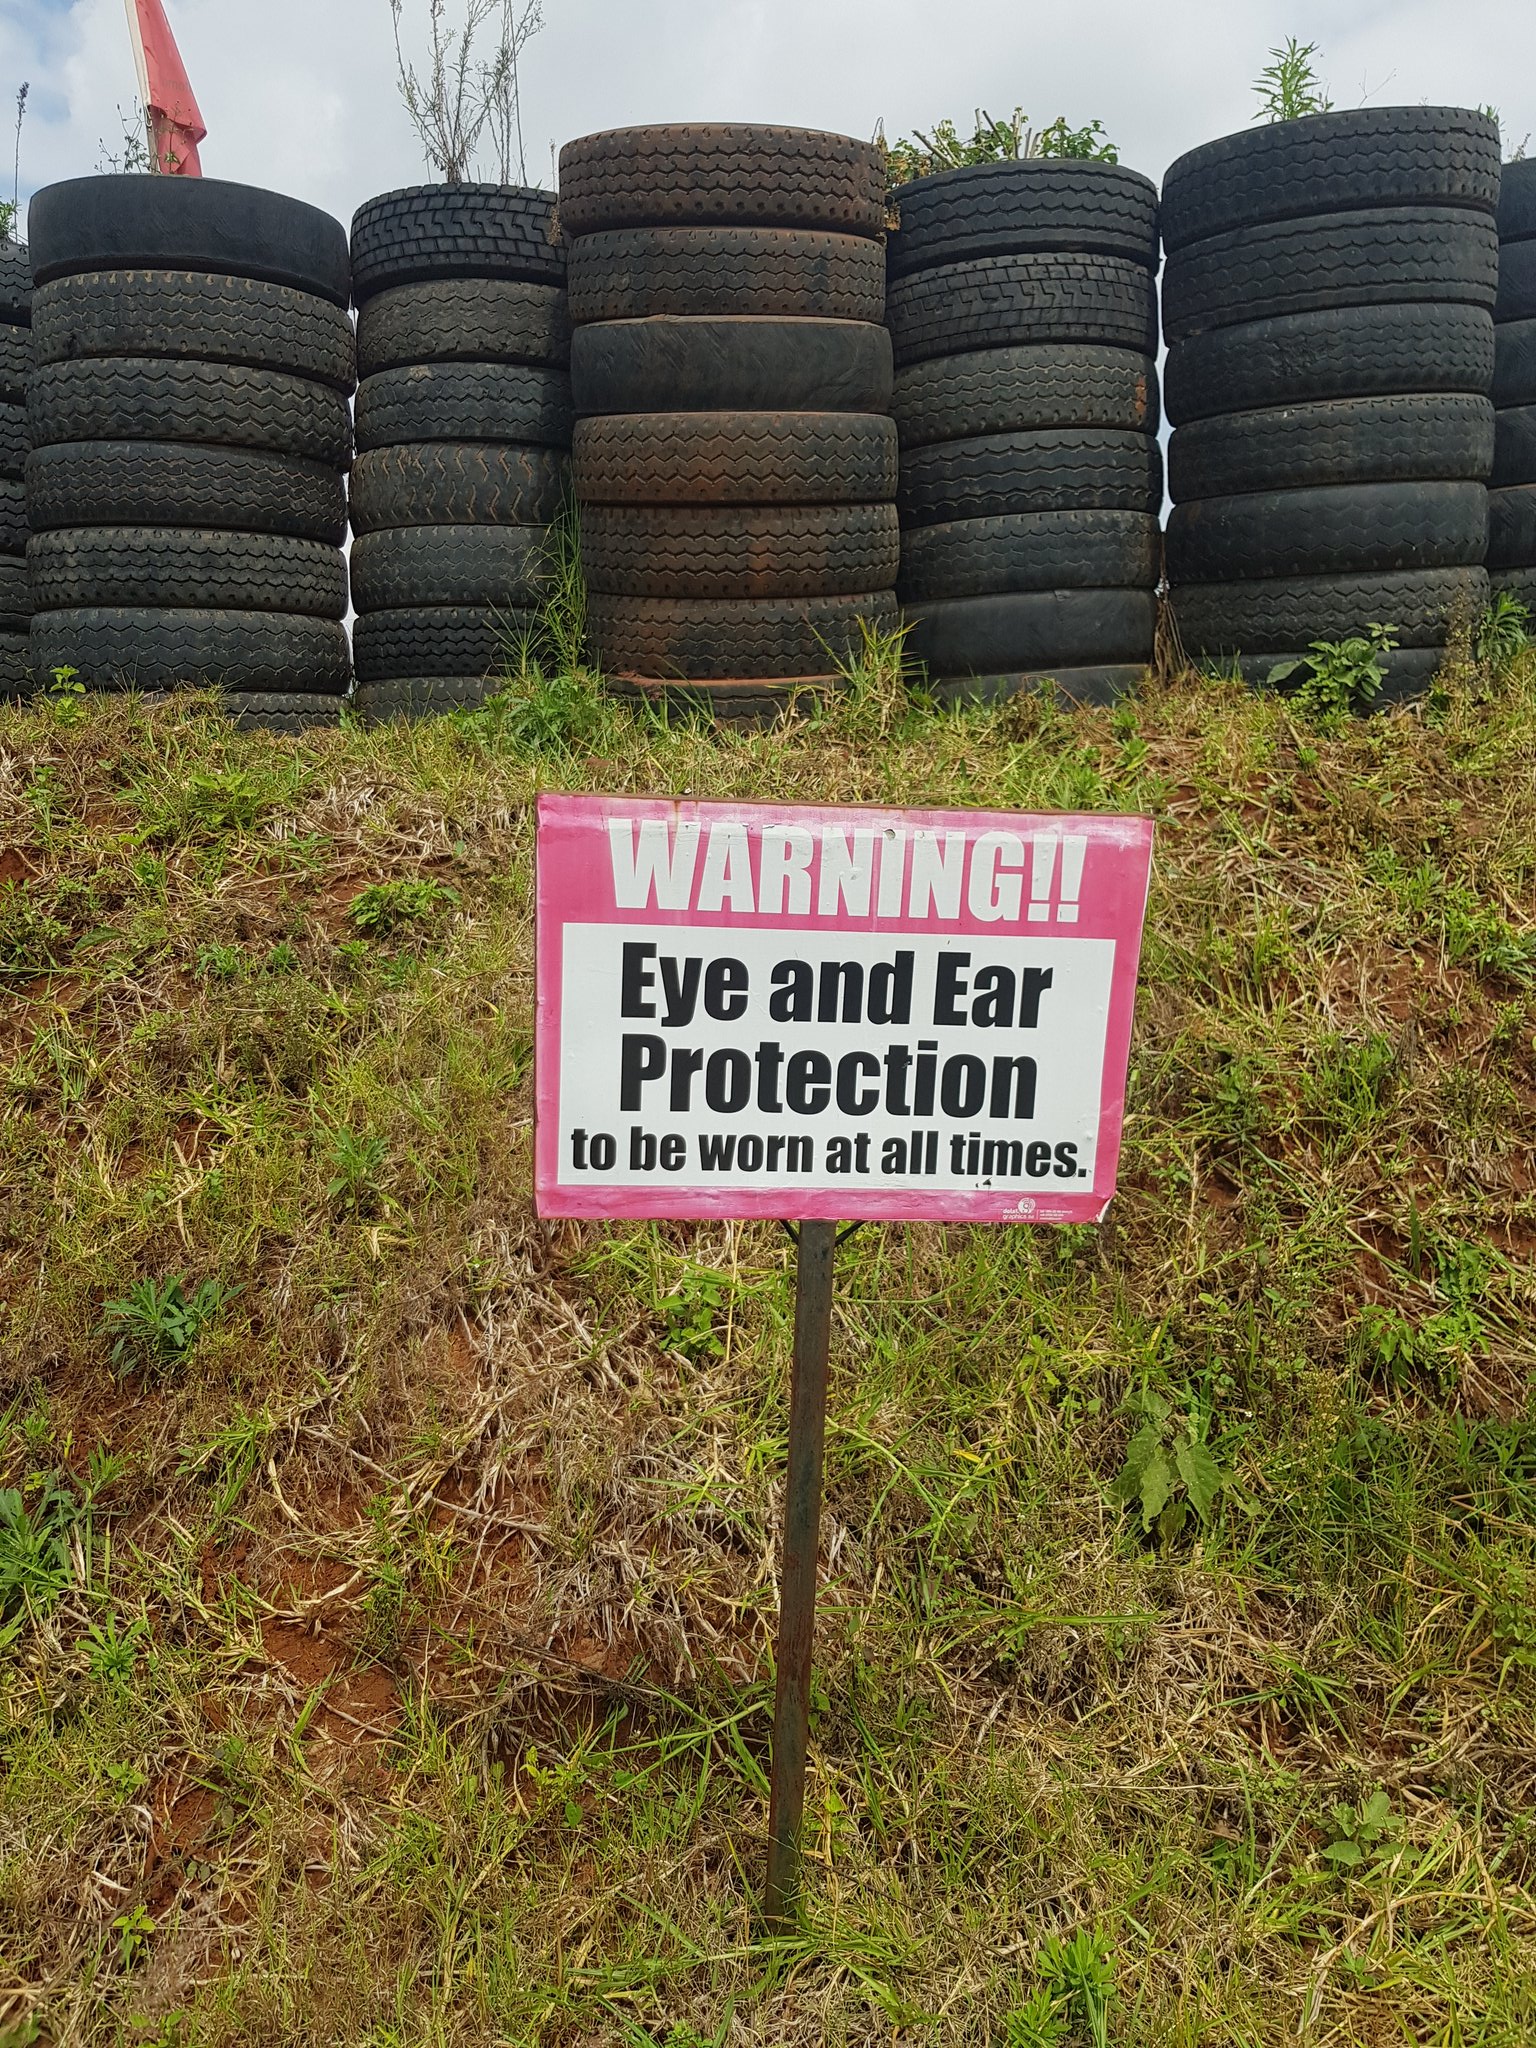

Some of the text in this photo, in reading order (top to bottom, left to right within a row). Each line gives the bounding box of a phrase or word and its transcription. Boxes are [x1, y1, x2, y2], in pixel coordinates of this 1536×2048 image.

[608, 818, 1088, 923] WARNING!!
[620, 942, 1053, 1029] Eye and Ear
[619, 1033, 1038, 1119] Protection
[571, 1127, 1087, 1178] to be worn at all times.
